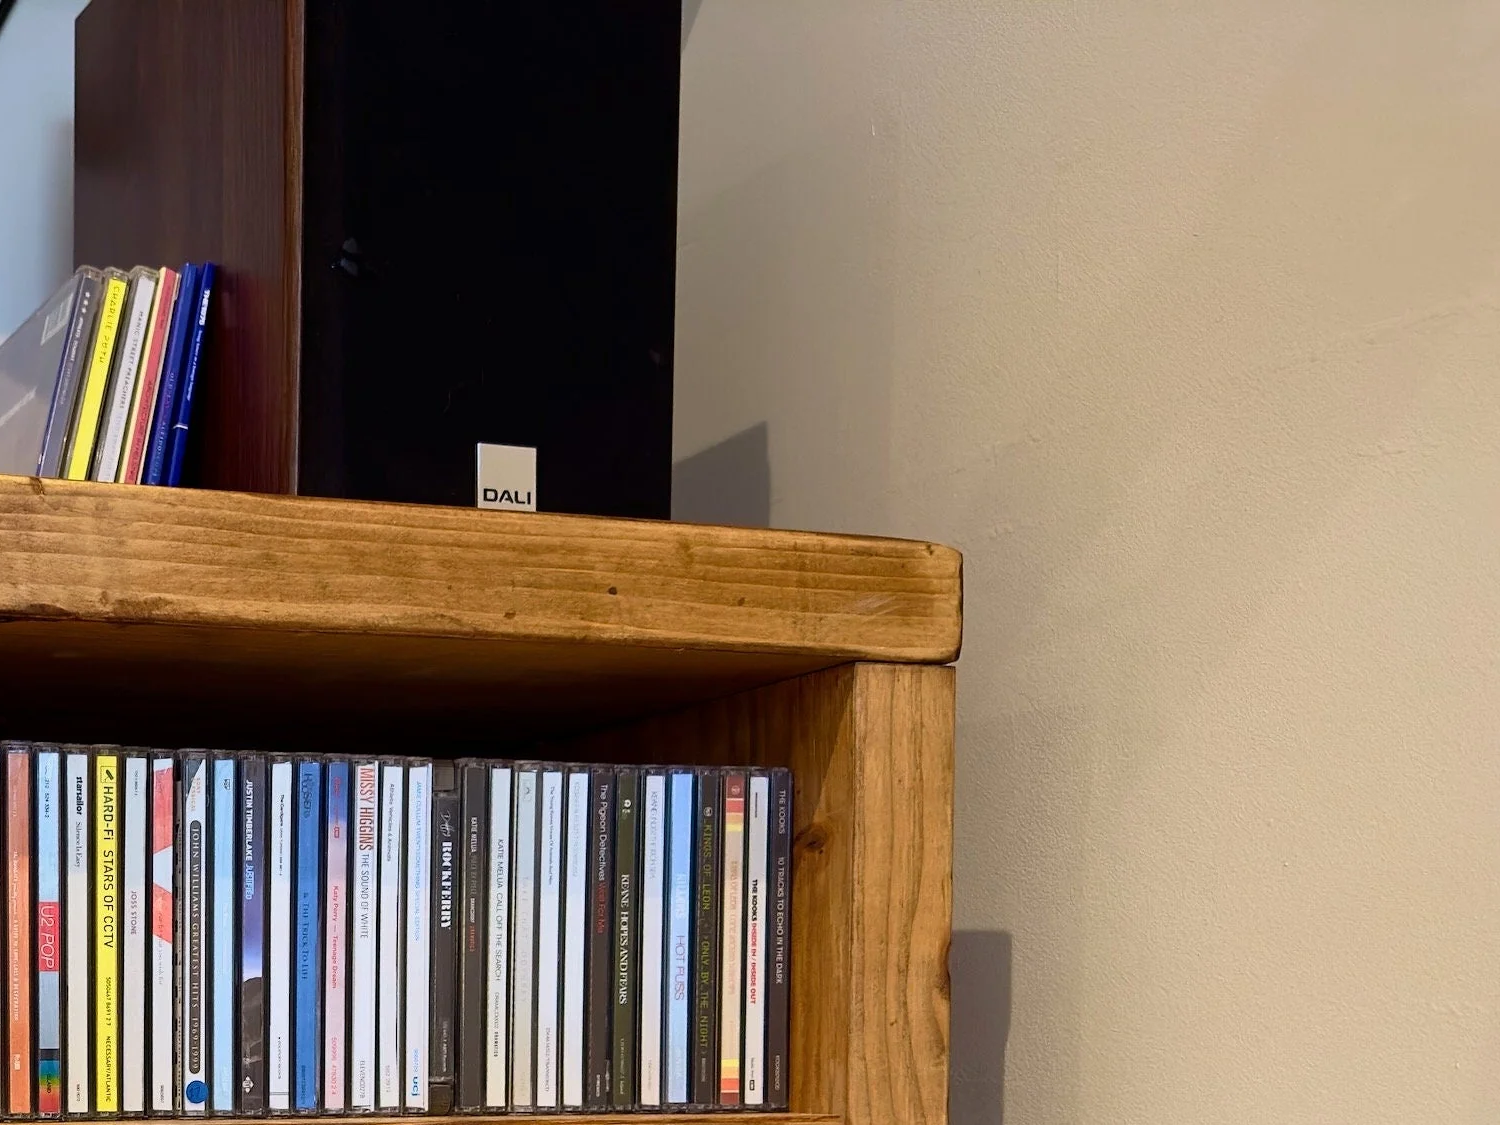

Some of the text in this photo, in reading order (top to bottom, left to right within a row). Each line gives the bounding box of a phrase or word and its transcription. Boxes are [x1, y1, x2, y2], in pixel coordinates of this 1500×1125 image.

[483, 487, 530, 504] DALI
[75, 776, 84, 815] starsailor
[245, 779, 253, 861] JUSTIN TIMBERLAKE
[597, 783, 607, 881] The Pigeon Detectives
[103, 849, 114, 890] STARS
[358, 767, 374, 938] MISSY HIGGINS THE SOUND OF WHITE
[440, 841, 453, 930] ROCKFERRY
[40, 905, 56, 969] U2 POP
[103, 895, 113, 911] OF
[103, 915, 114, 948] CCTV
[618, 874, 629, 1004] KEANE HOPES AND FEARS
[191, 827, 200, 1071] JOHN WILLIAMS GREATEST HITS 1969-1999
